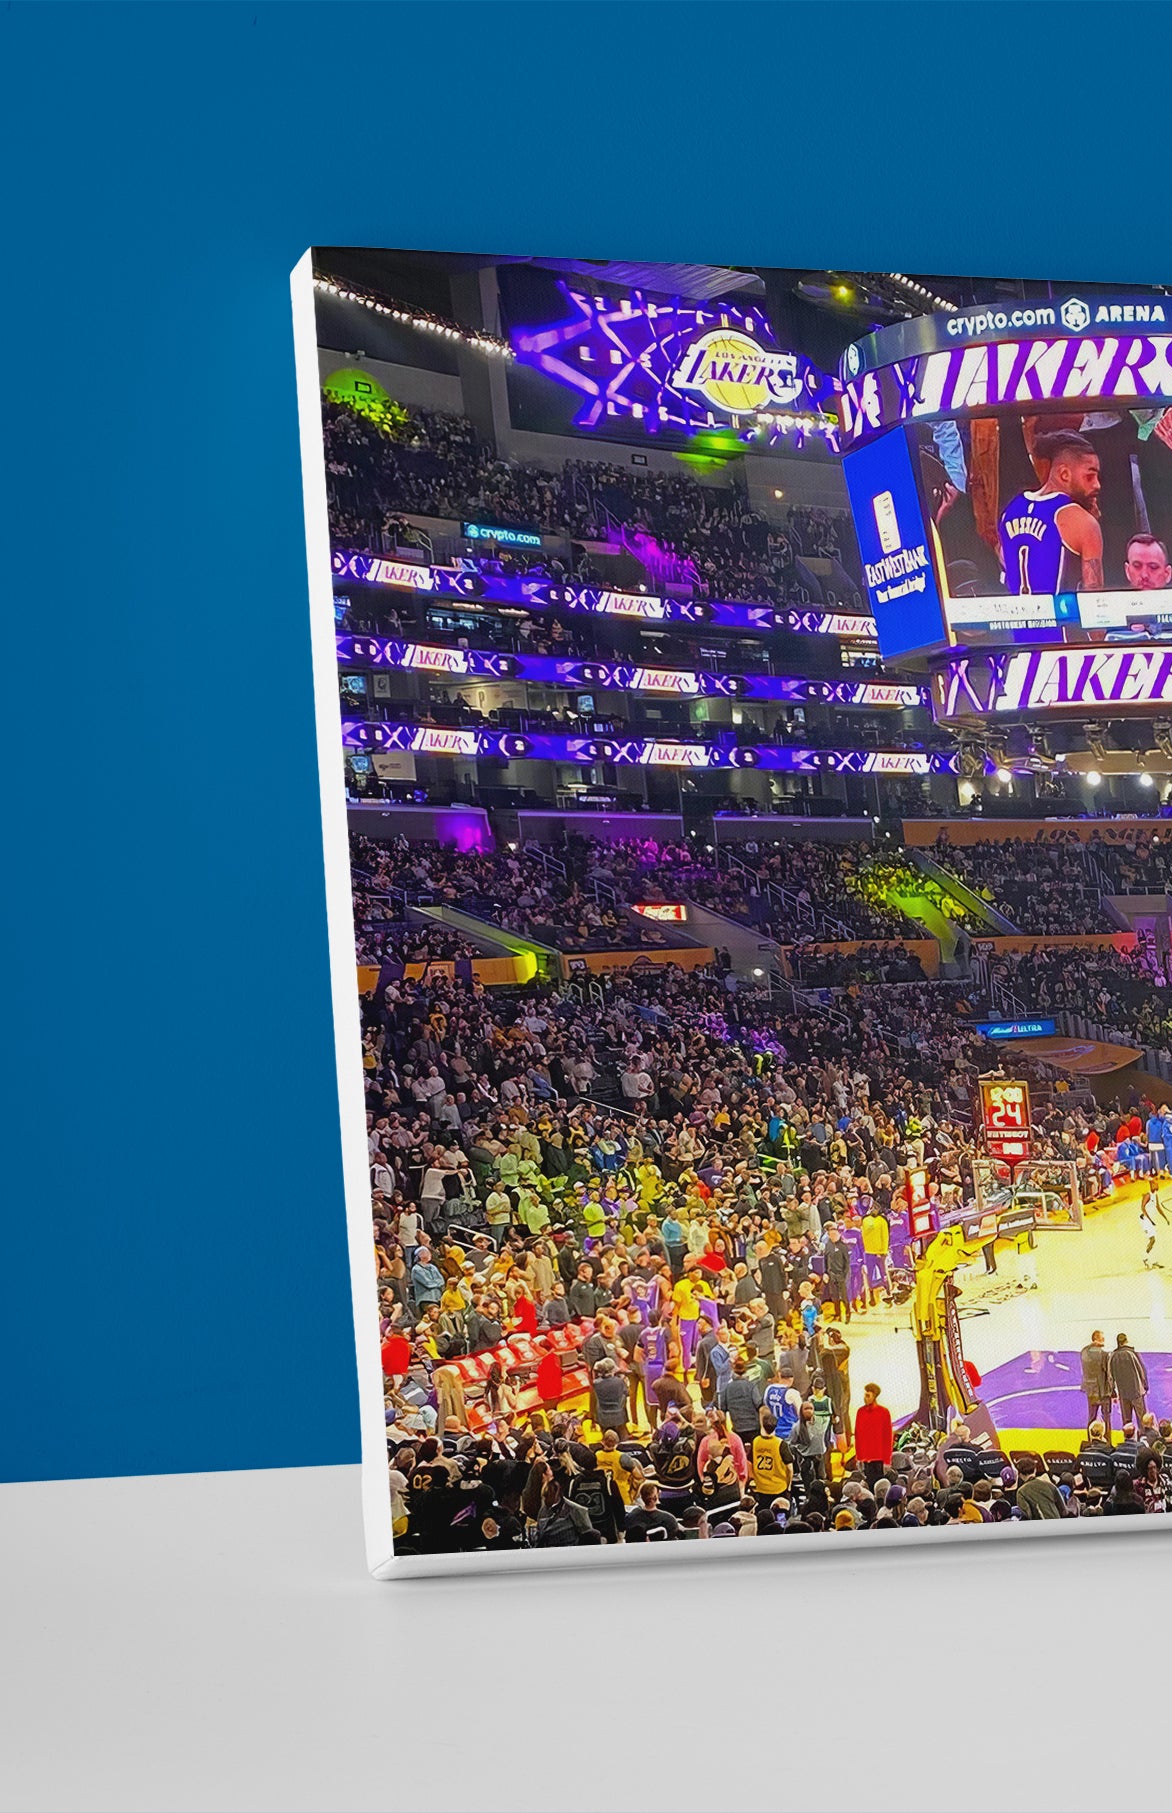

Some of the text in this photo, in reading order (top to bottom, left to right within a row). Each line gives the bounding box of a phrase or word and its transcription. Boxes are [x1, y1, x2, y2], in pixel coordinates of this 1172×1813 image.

[946, 304, 1166, 337] crypto.com ARENA
[685, 350, 797, 398] LAKERS
[992, 1102, 1023, 1127] 24
